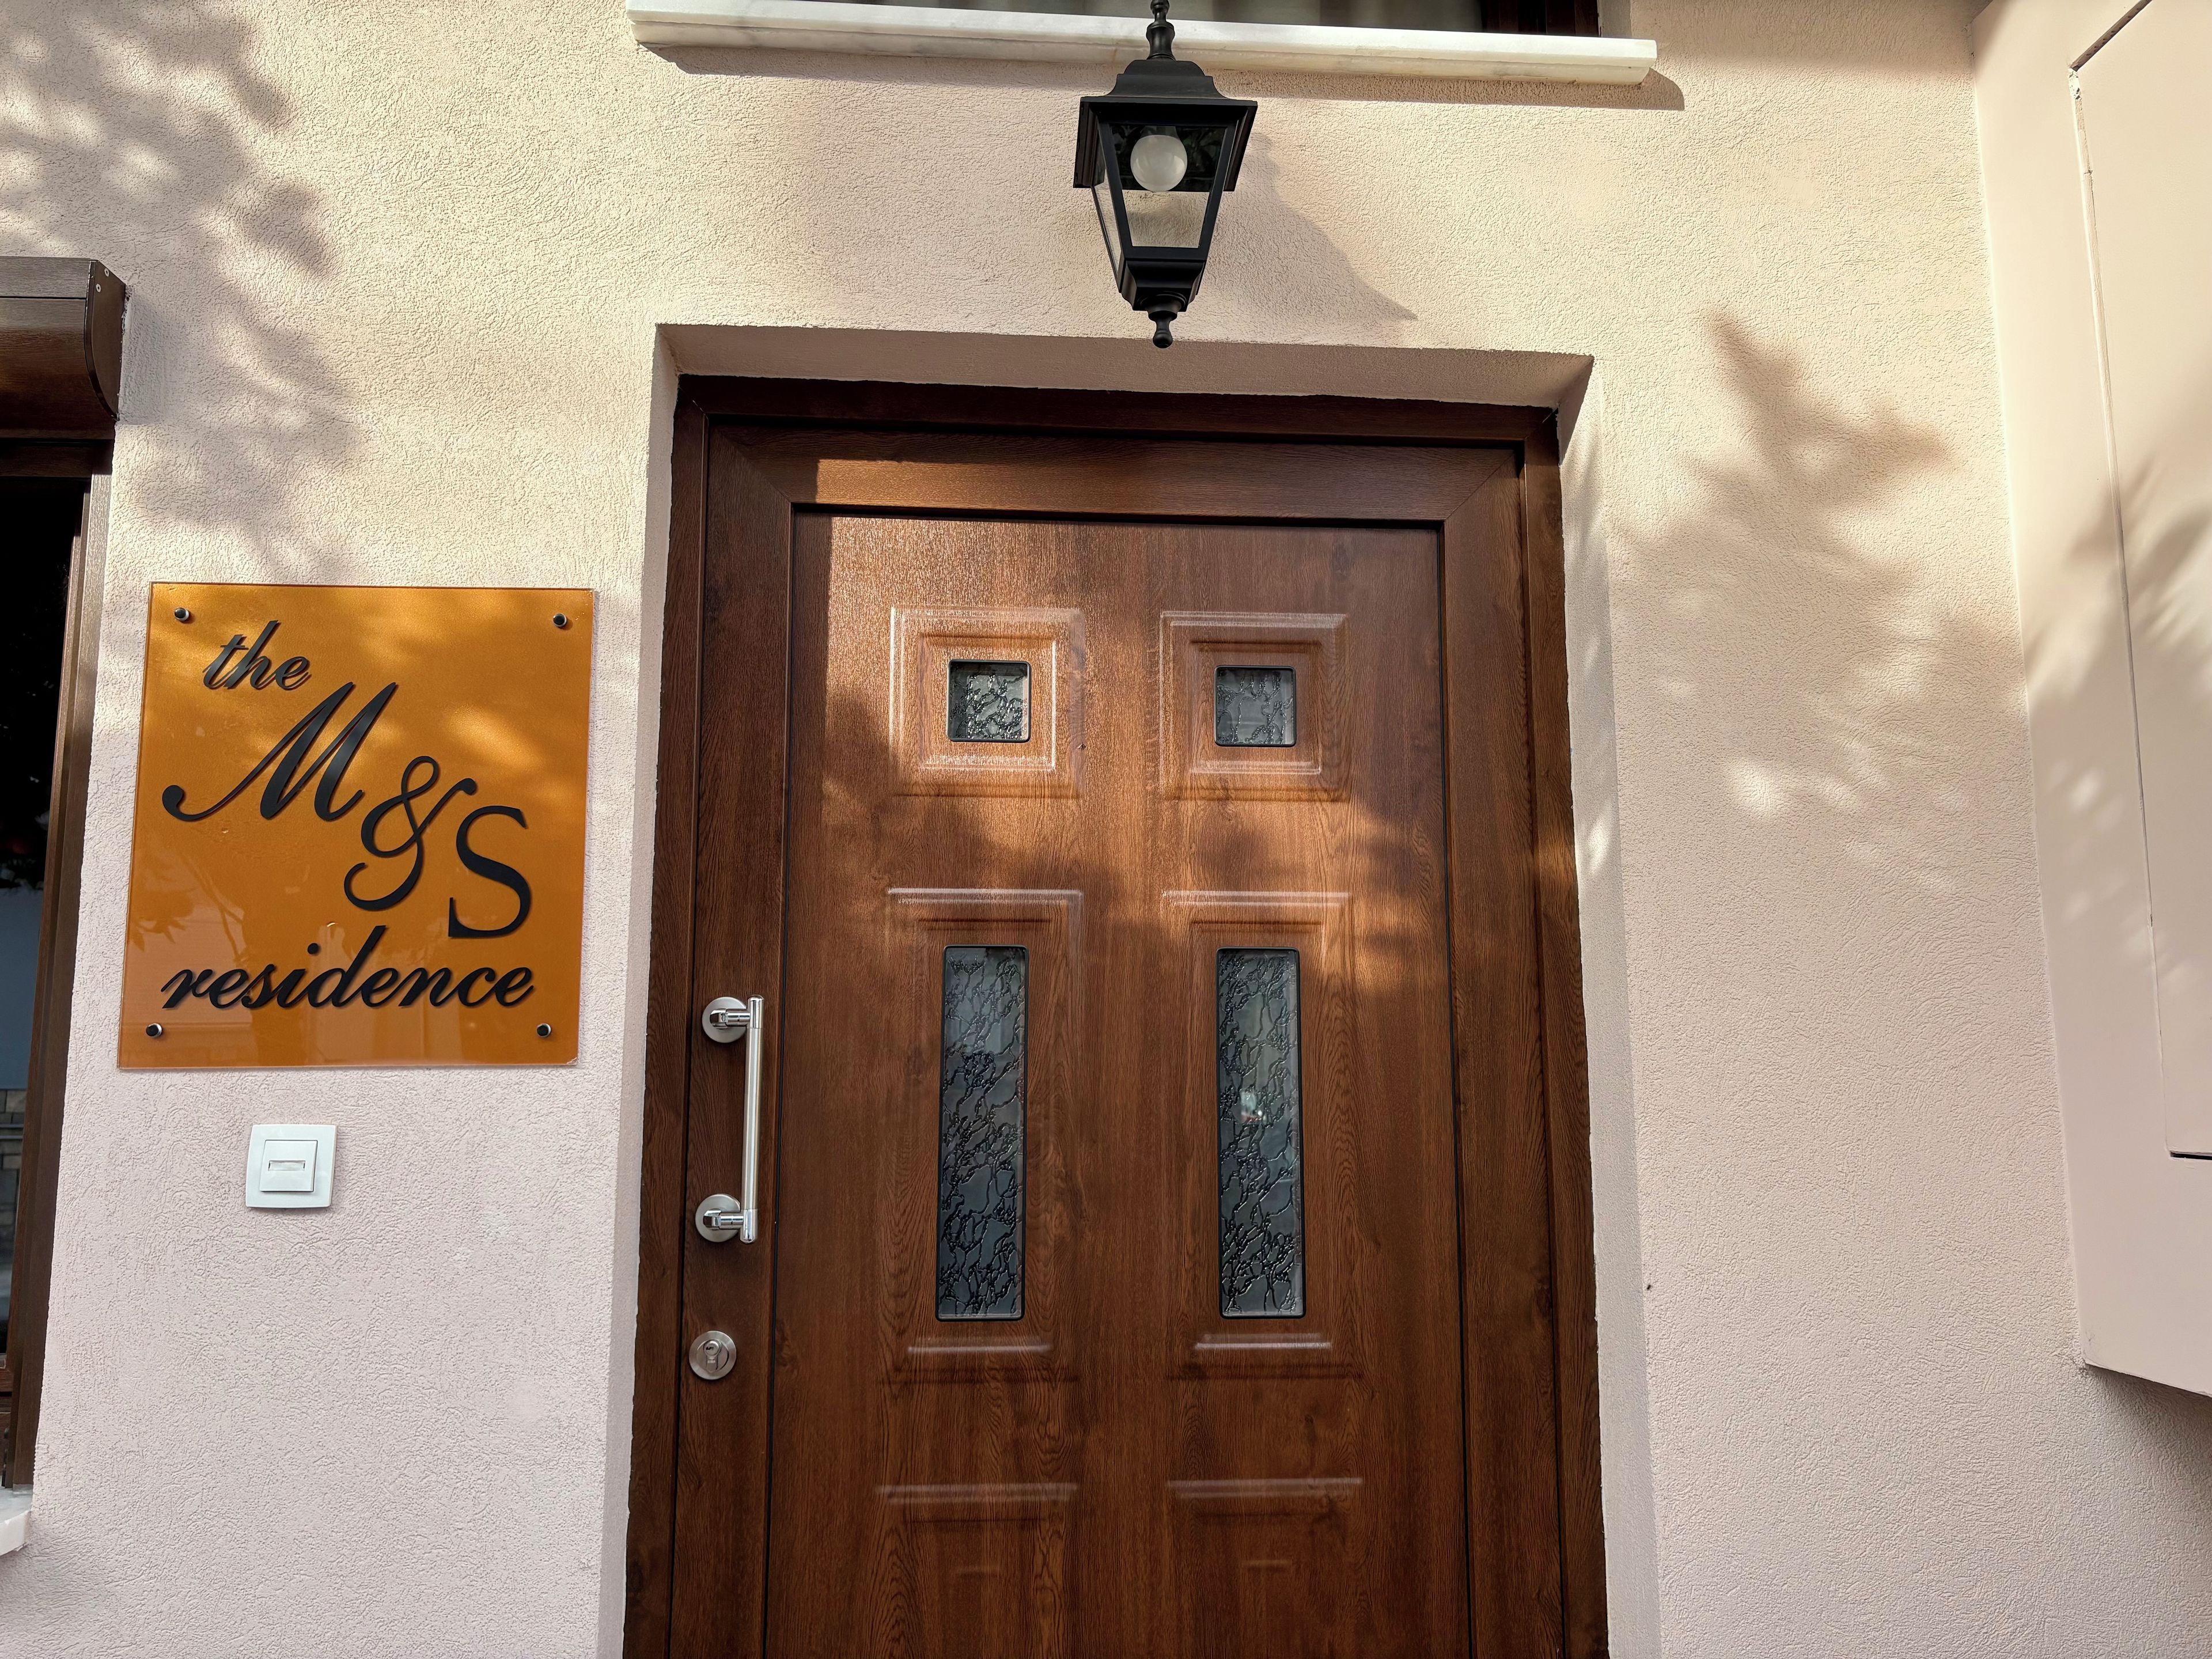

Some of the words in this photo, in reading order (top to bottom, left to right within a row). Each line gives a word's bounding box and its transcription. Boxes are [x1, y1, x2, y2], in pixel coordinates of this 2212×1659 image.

[203, 620, 311, 690] the
[162, 681, 532, 938] M&S
[161, 925, 534, 1009] residence
